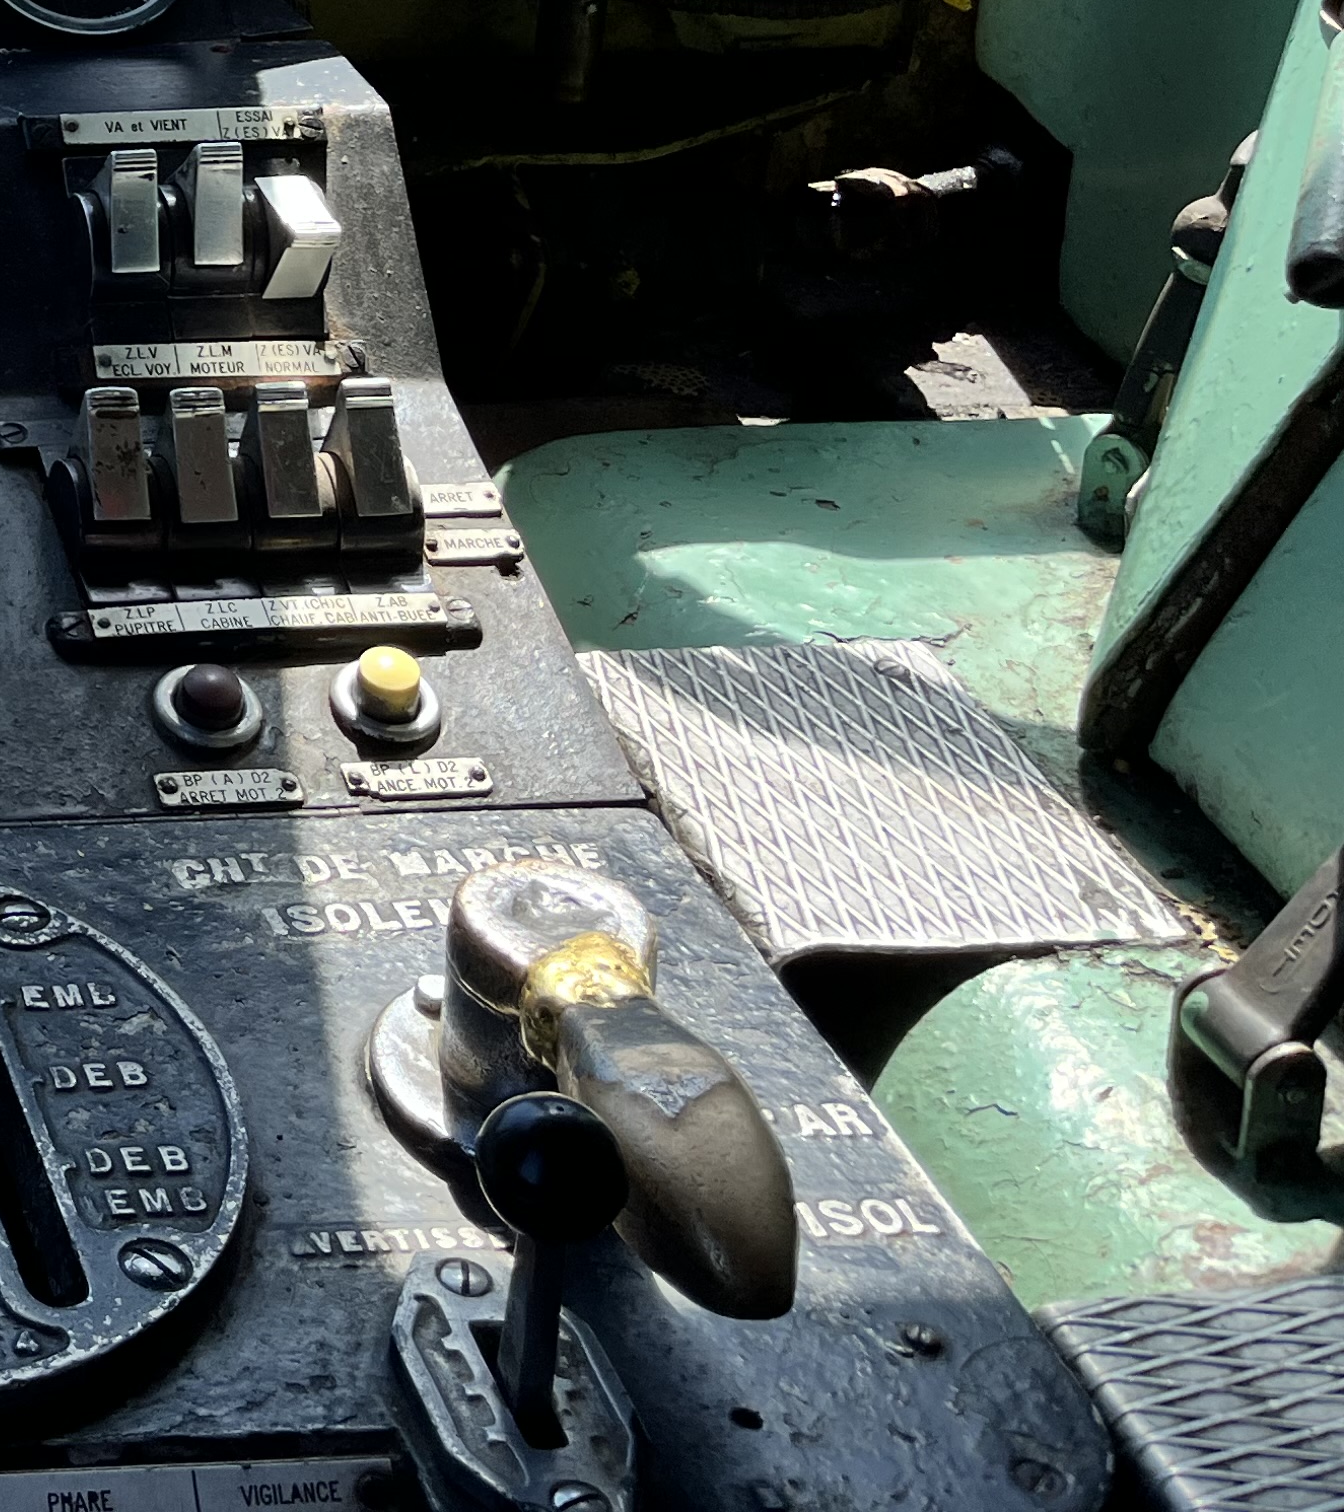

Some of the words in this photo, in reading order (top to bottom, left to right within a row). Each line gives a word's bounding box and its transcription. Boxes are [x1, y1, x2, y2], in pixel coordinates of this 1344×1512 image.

[104, 120, 125, 134] VA
[131, 120, 144, 132] et
[149, 118, 188, 132] VIENT
[235, 110, 273, 123] ESSAI
[190, 360, 245, 374] MOTEUR
[265, 359, 318, 373] NORMAL
[429, 490, 473, 504] ARRET
[444, 537, 504, 550] MARCHE
[200, 615, 253, 629] CABINE
[326, 610, 355, 623] CAB
[114, 618, 177, 636] PUPITRE
[183, 772, 206, 786] BP
[252, 770, 271, 785] D2
[180, 789, 227, 805] ARRET
[300, 853, 371, 883] DE
[20, 983, 117, 1012] EMB
[49, 1061, 150, 1091] DEB
[86, 1145, 191, 1175] DEB
[108, 1186, 210, 1217] EMB
[13, 1331, 44, 1357] 4
[48, 1489, 114, 1512] PHARE
[239, 1479, 342, 1508] VIGILANCE
